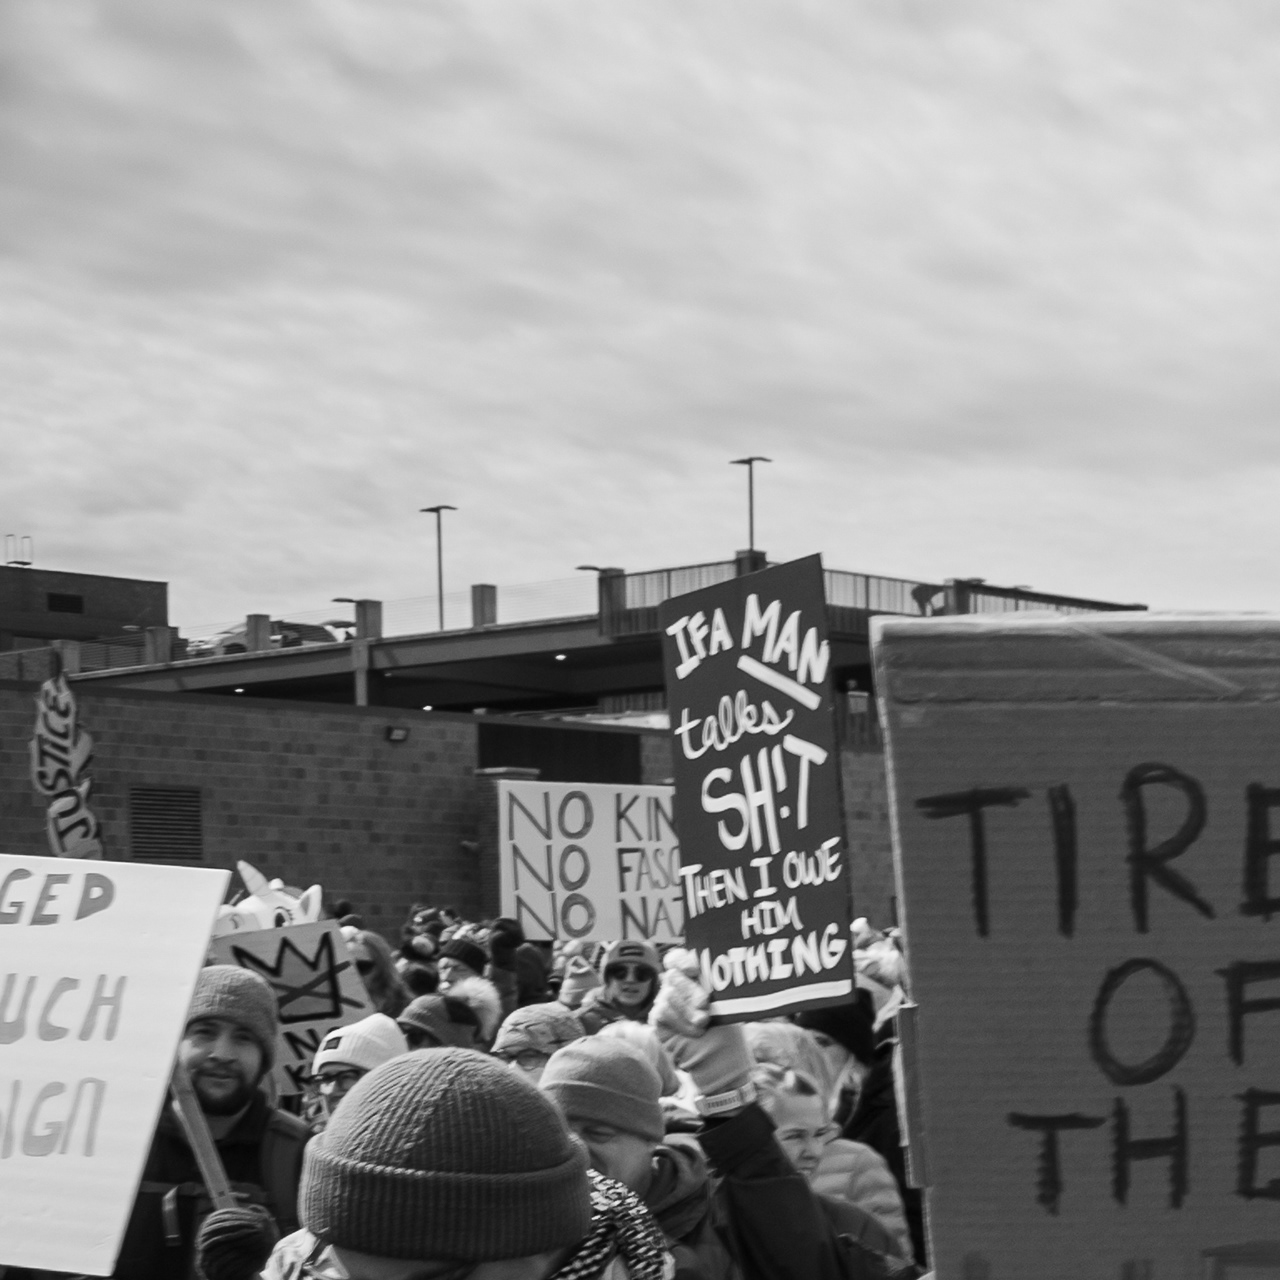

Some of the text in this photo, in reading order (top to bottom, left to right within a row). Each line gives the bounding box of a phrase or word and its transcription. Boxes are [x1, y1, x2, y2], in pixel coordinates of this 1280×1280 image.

[741, 593, 831, 685] MAN
[674, 689, 794, 760] talks
[508, 790, 679, 843] NO KIN
[701, 734, 828, 854] SH!T
[512, 844, 681, 892] NO FASC
[678, 836, 842, 919] THEN I OWE
[515, 893, 684, 941] NO NA
[741, 896, 804, 939] HIM
[697, 922, 848, 993] NOTHING
